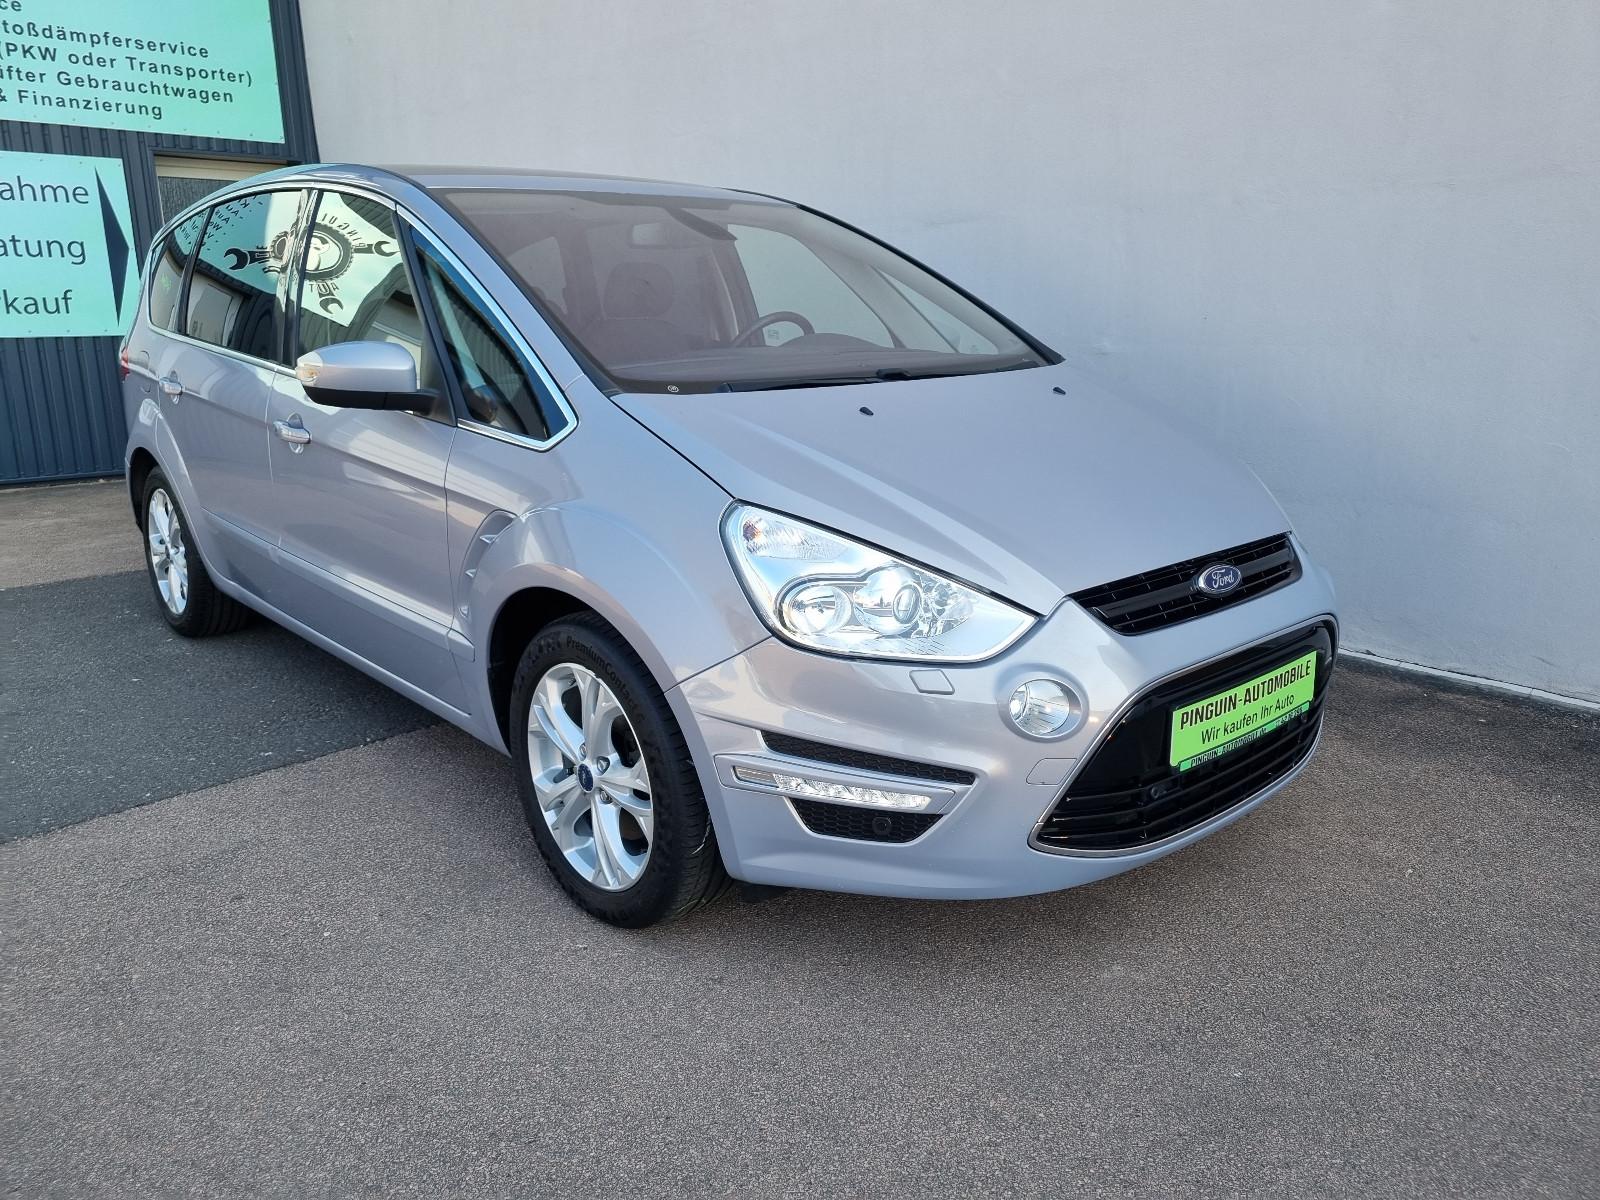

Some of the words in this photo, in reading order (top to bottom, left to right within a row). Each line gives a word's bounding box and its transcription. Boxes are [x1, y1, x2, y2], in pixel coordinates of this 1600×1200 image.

[1, 19, 209, 58] toßdämpferservice
[68, 52, 117, 70] oder
[125, 56, 252, 87] Transporter)
[57, 71, 234, 104] Gebrauchtwagen
[18, 90, 163, 120] Finanzierung
[0, 176, 89, 204] ahme
[0, 288, 73, 315] kauf
[1212, 568, 1235, 589] Ford
[1180, 659, 1312, 730] PINGUIN-AUTOMOBILE
[1201, 725, 1221, 745] Wir
[1223, 713, 1258, 737] kaufen
[1260, 704, 1273, 721] Ihr
[1274, 693, 1295, 712] Auto
